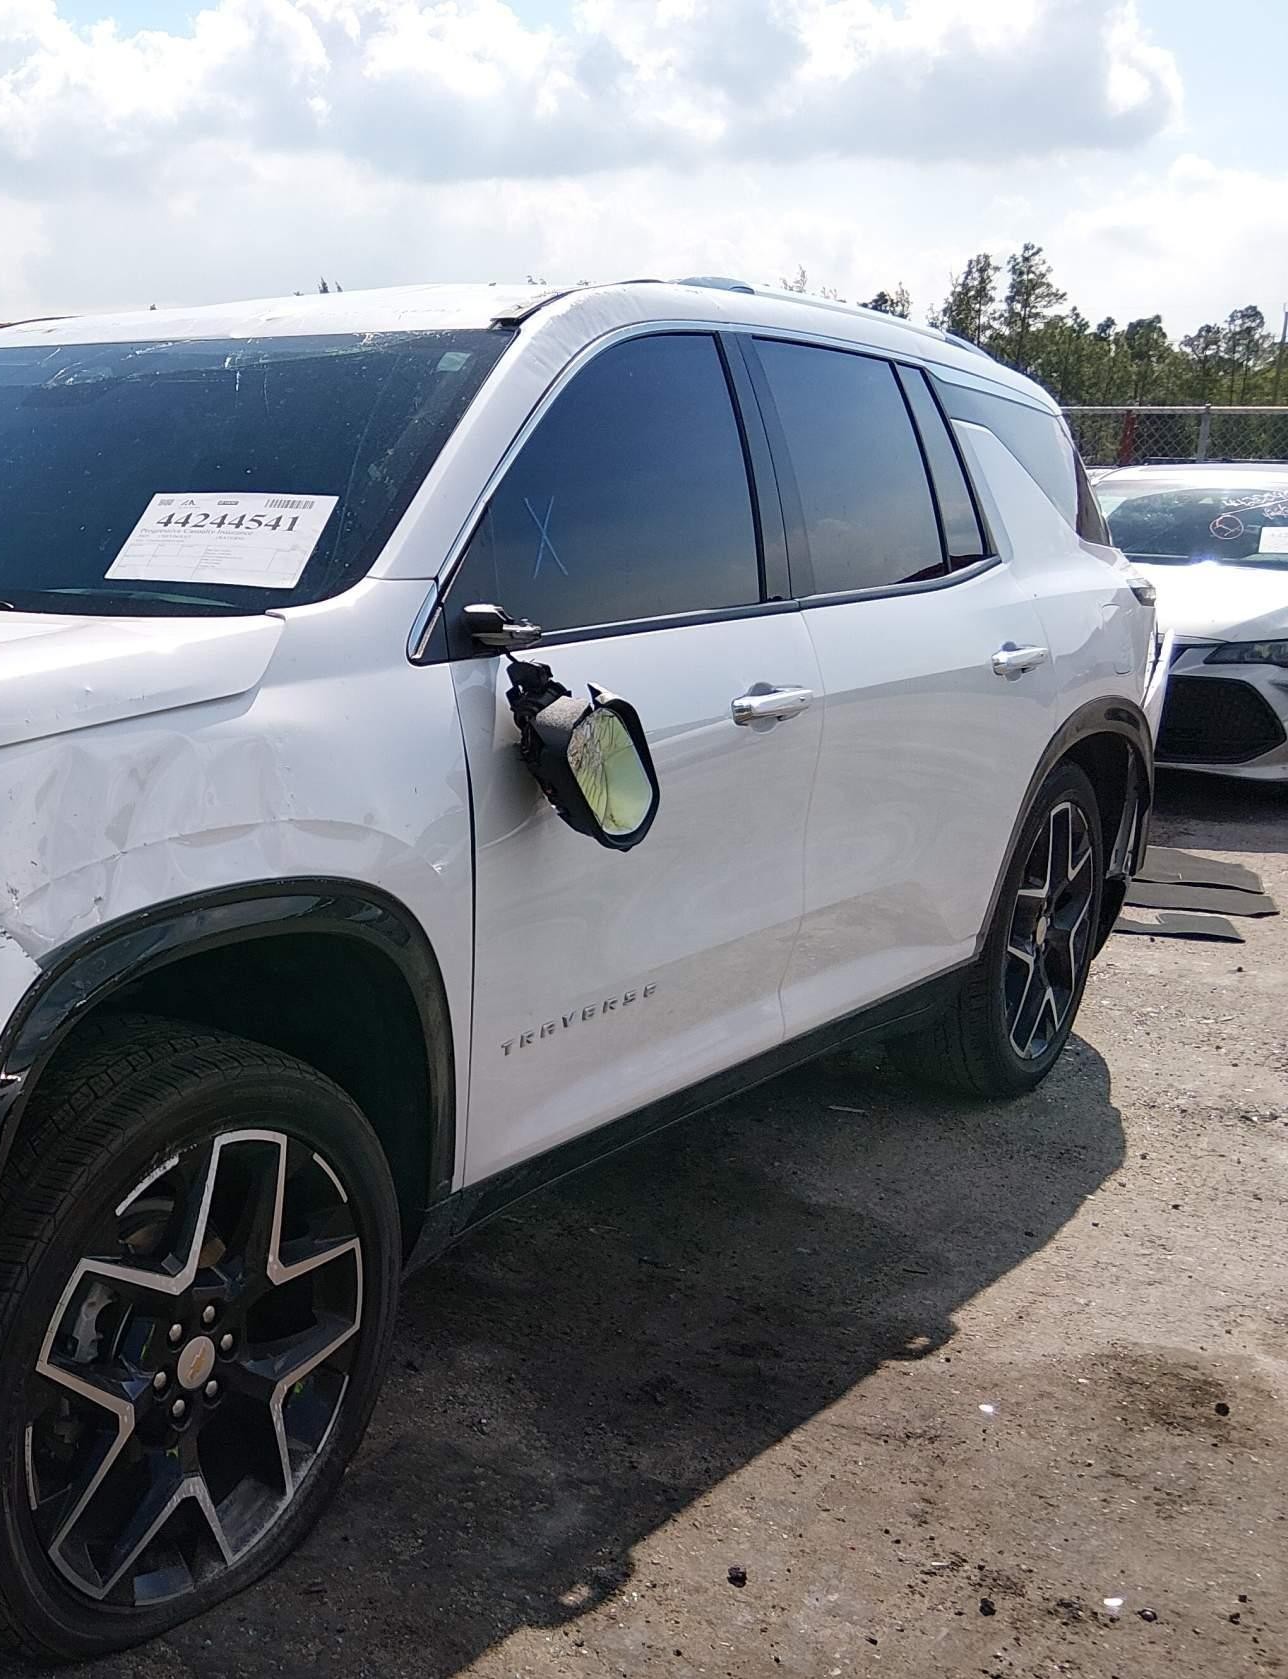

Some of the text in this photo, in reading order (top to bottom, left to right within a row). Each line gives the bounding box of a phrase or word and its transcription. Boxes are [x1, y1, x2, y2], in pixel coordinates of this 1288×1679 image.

[140, 527, 182, 535] Progressive
[216, 529, 254, 537] Insurance
[156, 512, 300, 532] 44244541
[500, 982, 657, 1056] TRAVERSE
